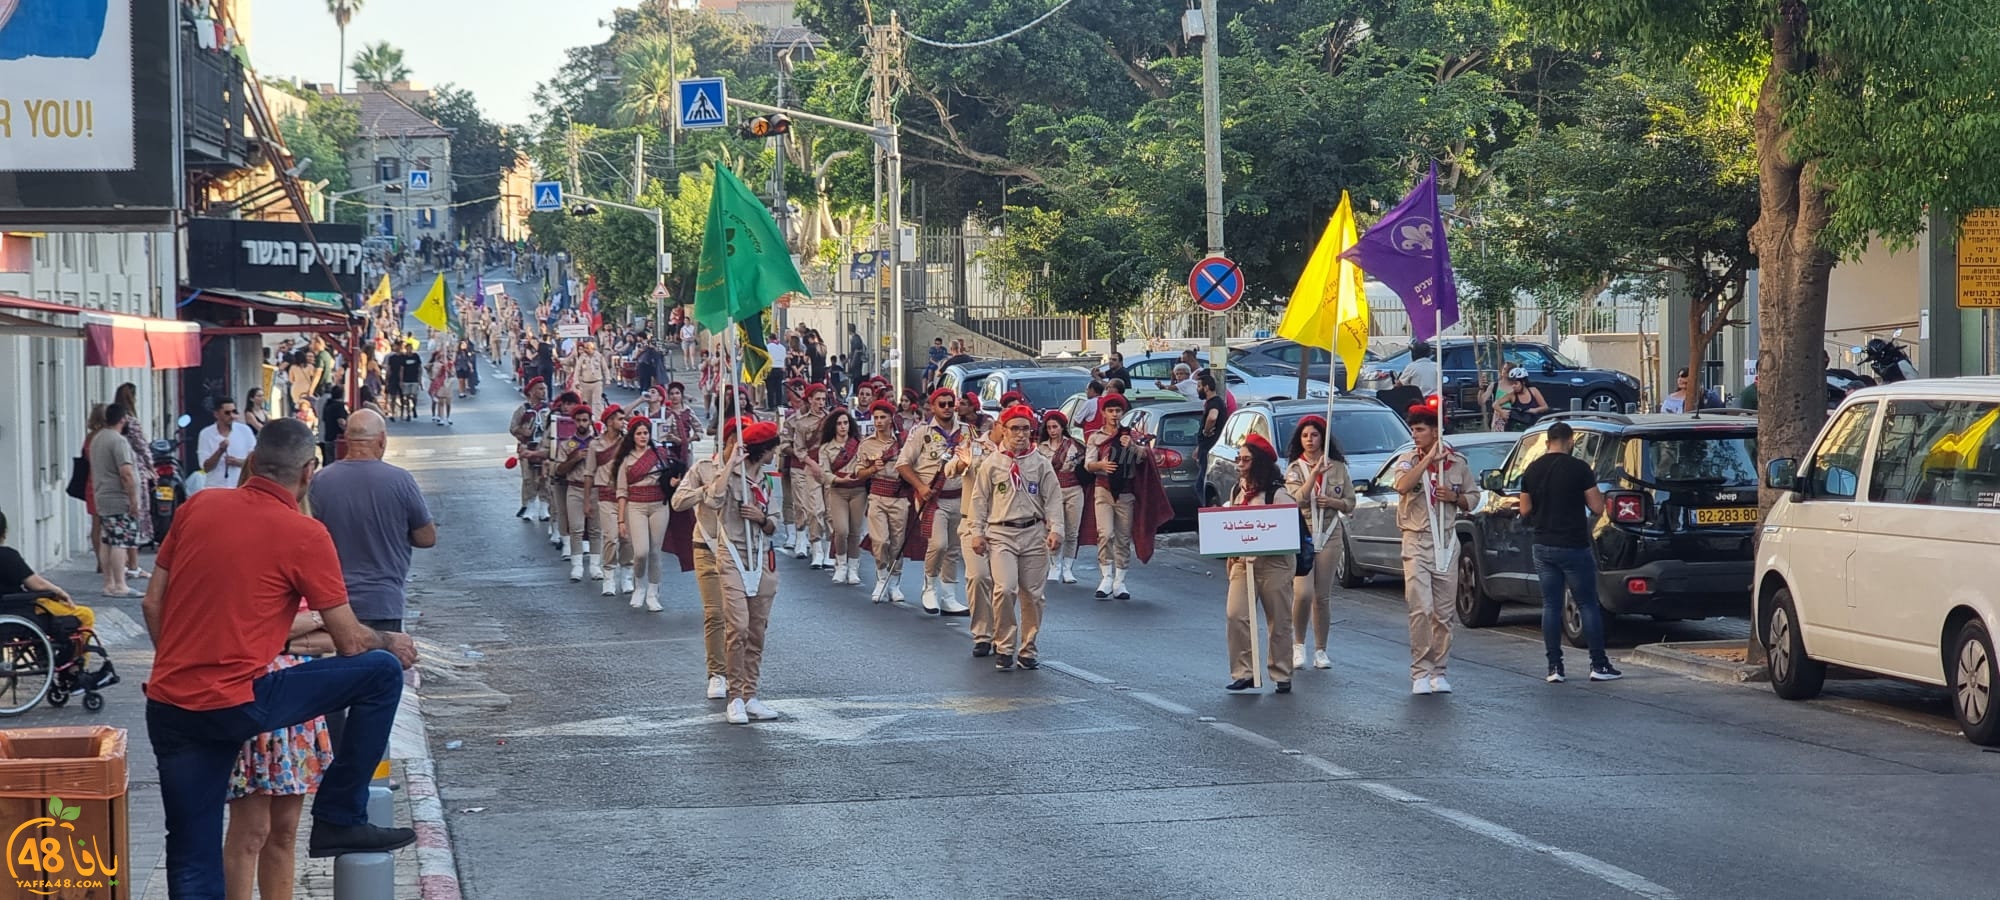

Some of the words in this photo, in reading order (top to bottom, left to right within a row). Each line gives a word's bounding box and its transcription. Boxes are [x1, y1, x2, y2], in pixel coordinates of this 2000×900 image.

[24, 99, 93, 137] YOU!
[241, 239, 297, 266] הגשר
[299, 242, 362, 274] קיוסק
[1715, 492, 1737, 501] Jeep
[1222, 519, 1254, 530] كشافة
[1256, 520, 1277, 531] سرية
[1241, 535, 1258, 544] معليا
